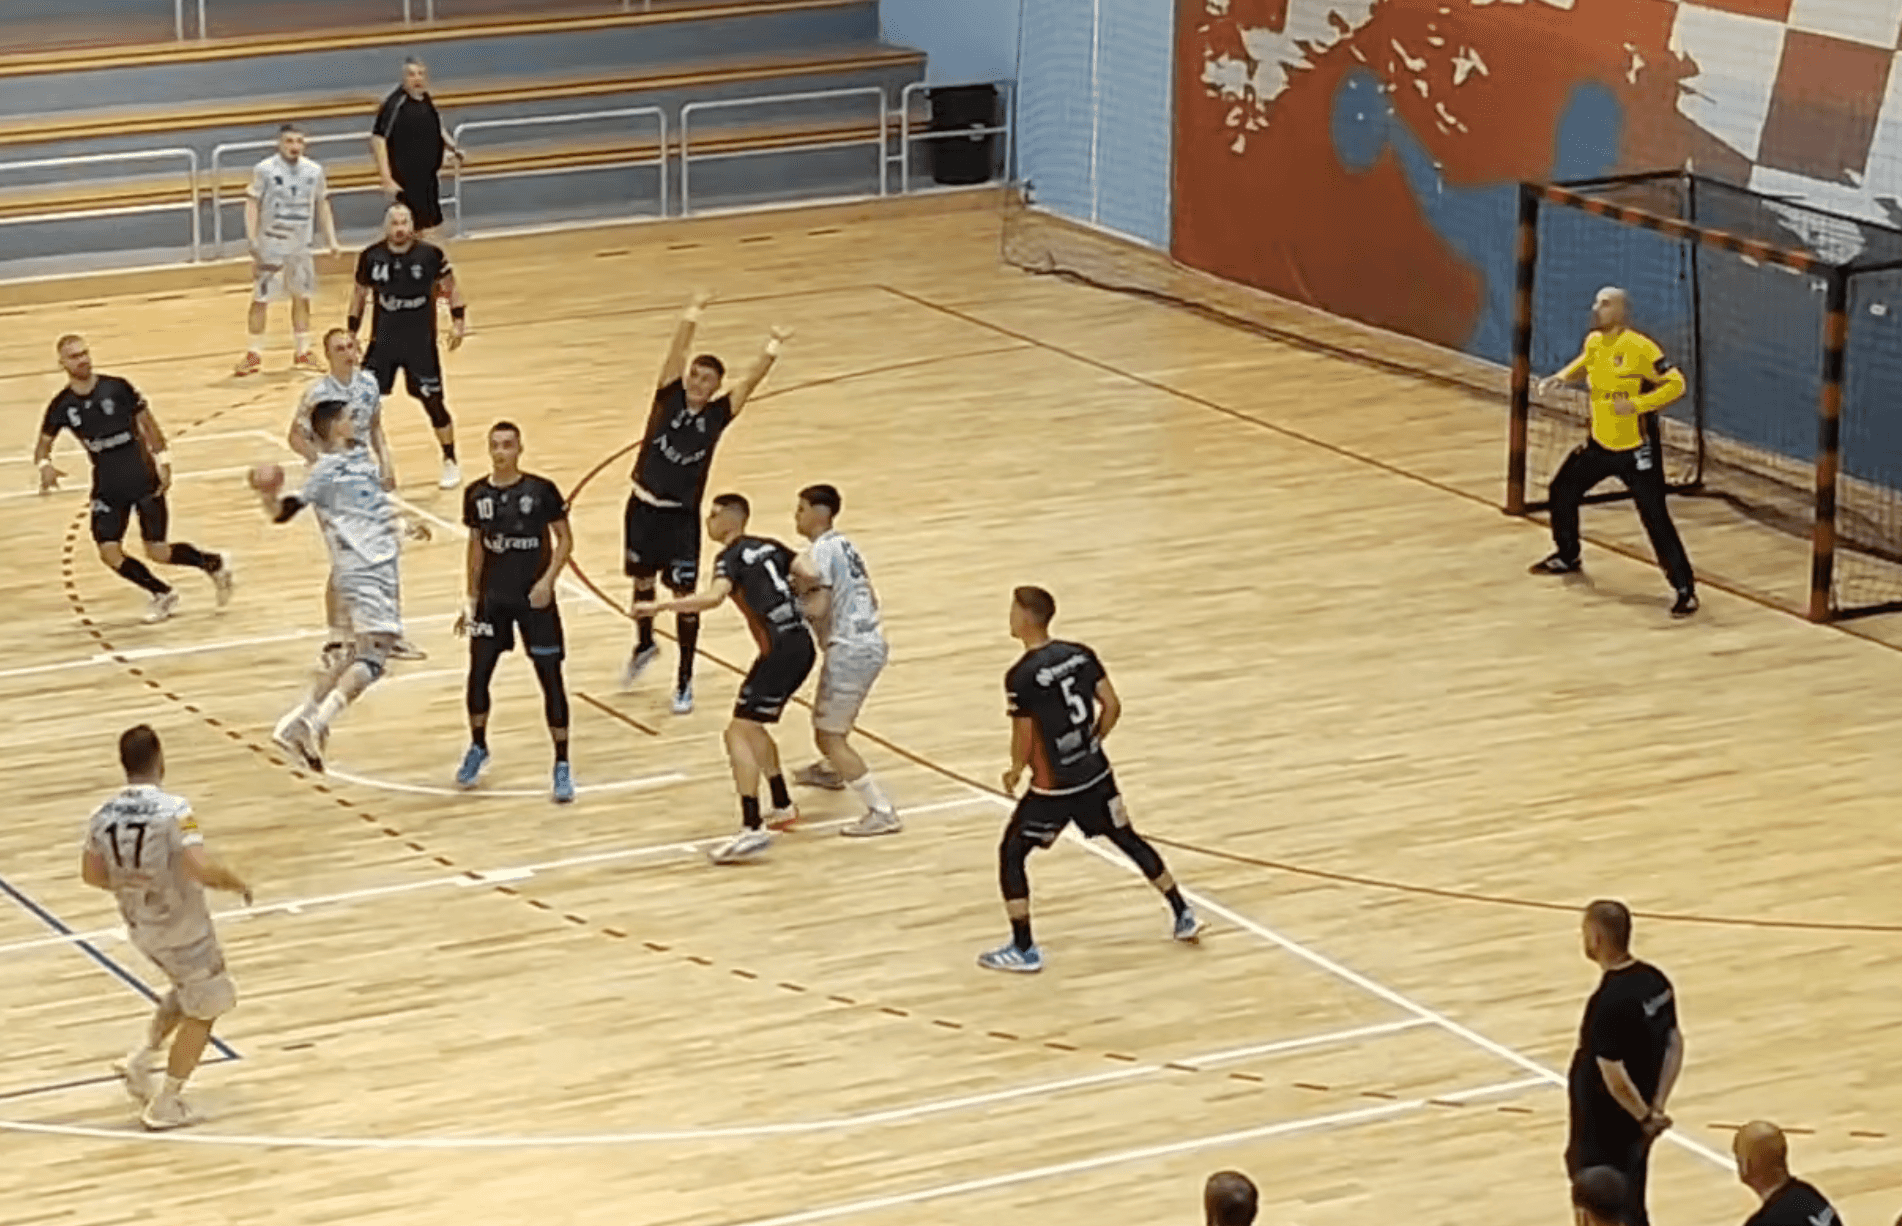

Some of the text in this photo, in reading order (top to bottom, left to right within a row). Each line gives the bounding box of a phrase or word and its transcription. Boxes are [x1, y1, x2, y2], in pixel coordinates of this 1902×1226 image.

[476, 497, 494, 520] 10
[1061, 676, 1088, 725] 5
[105, 822, 147, 869] 17
